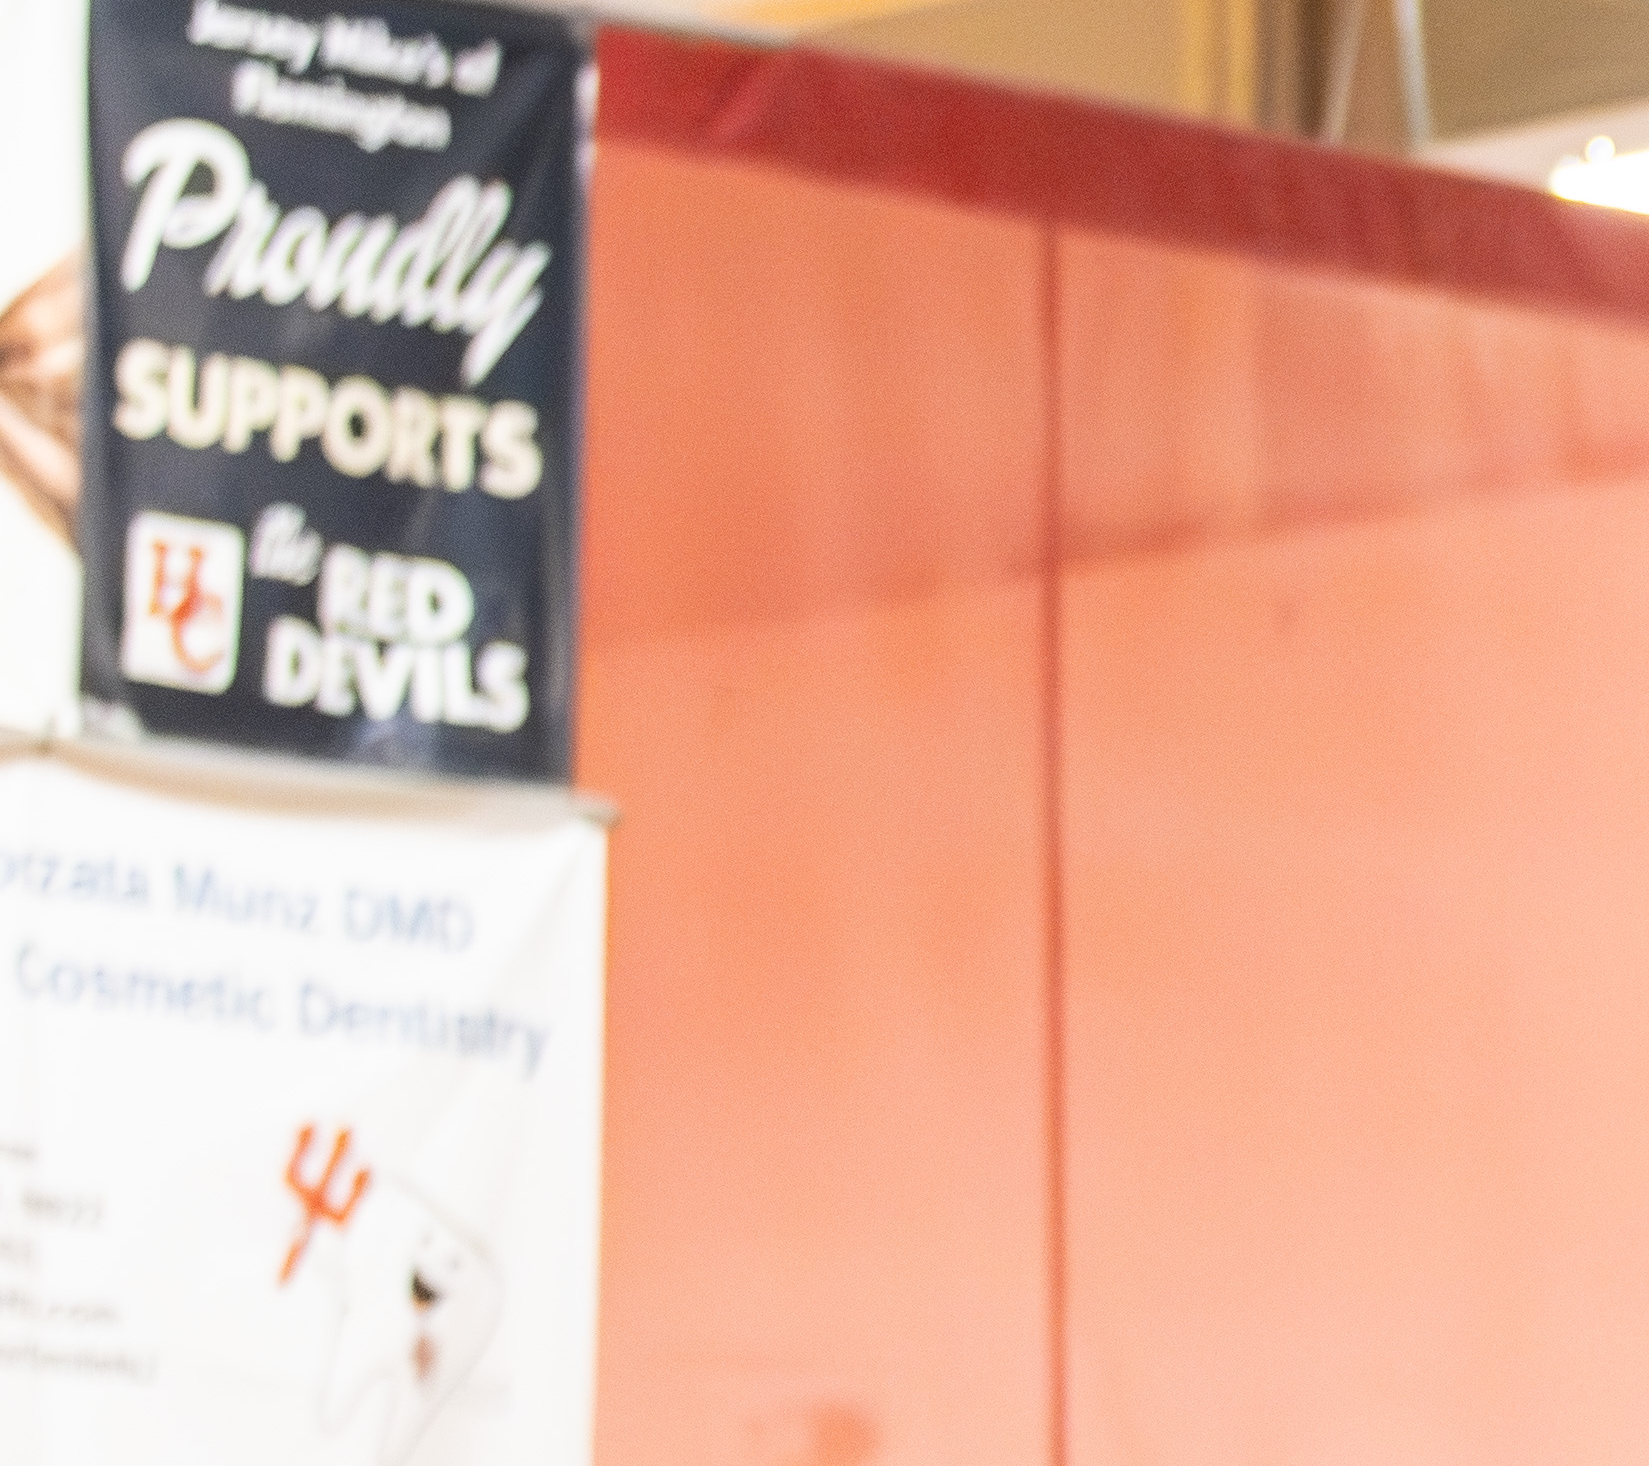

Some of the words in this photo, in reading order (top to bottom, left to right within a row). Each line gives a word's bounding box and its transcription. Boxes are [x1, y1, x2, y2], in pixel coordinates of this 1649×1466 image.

[122, 119, 554, 389] Proudly
[113, 338, 544, 502] SUPPORTS
[318, 544, 476, 644] RED
[263, 614, 530, 734] DEVILS
[344, 886, 478, 956] DMD
[13, 937, 278, 1034] Cosmetic
[299, 978, 554, 1082] Dentistry
